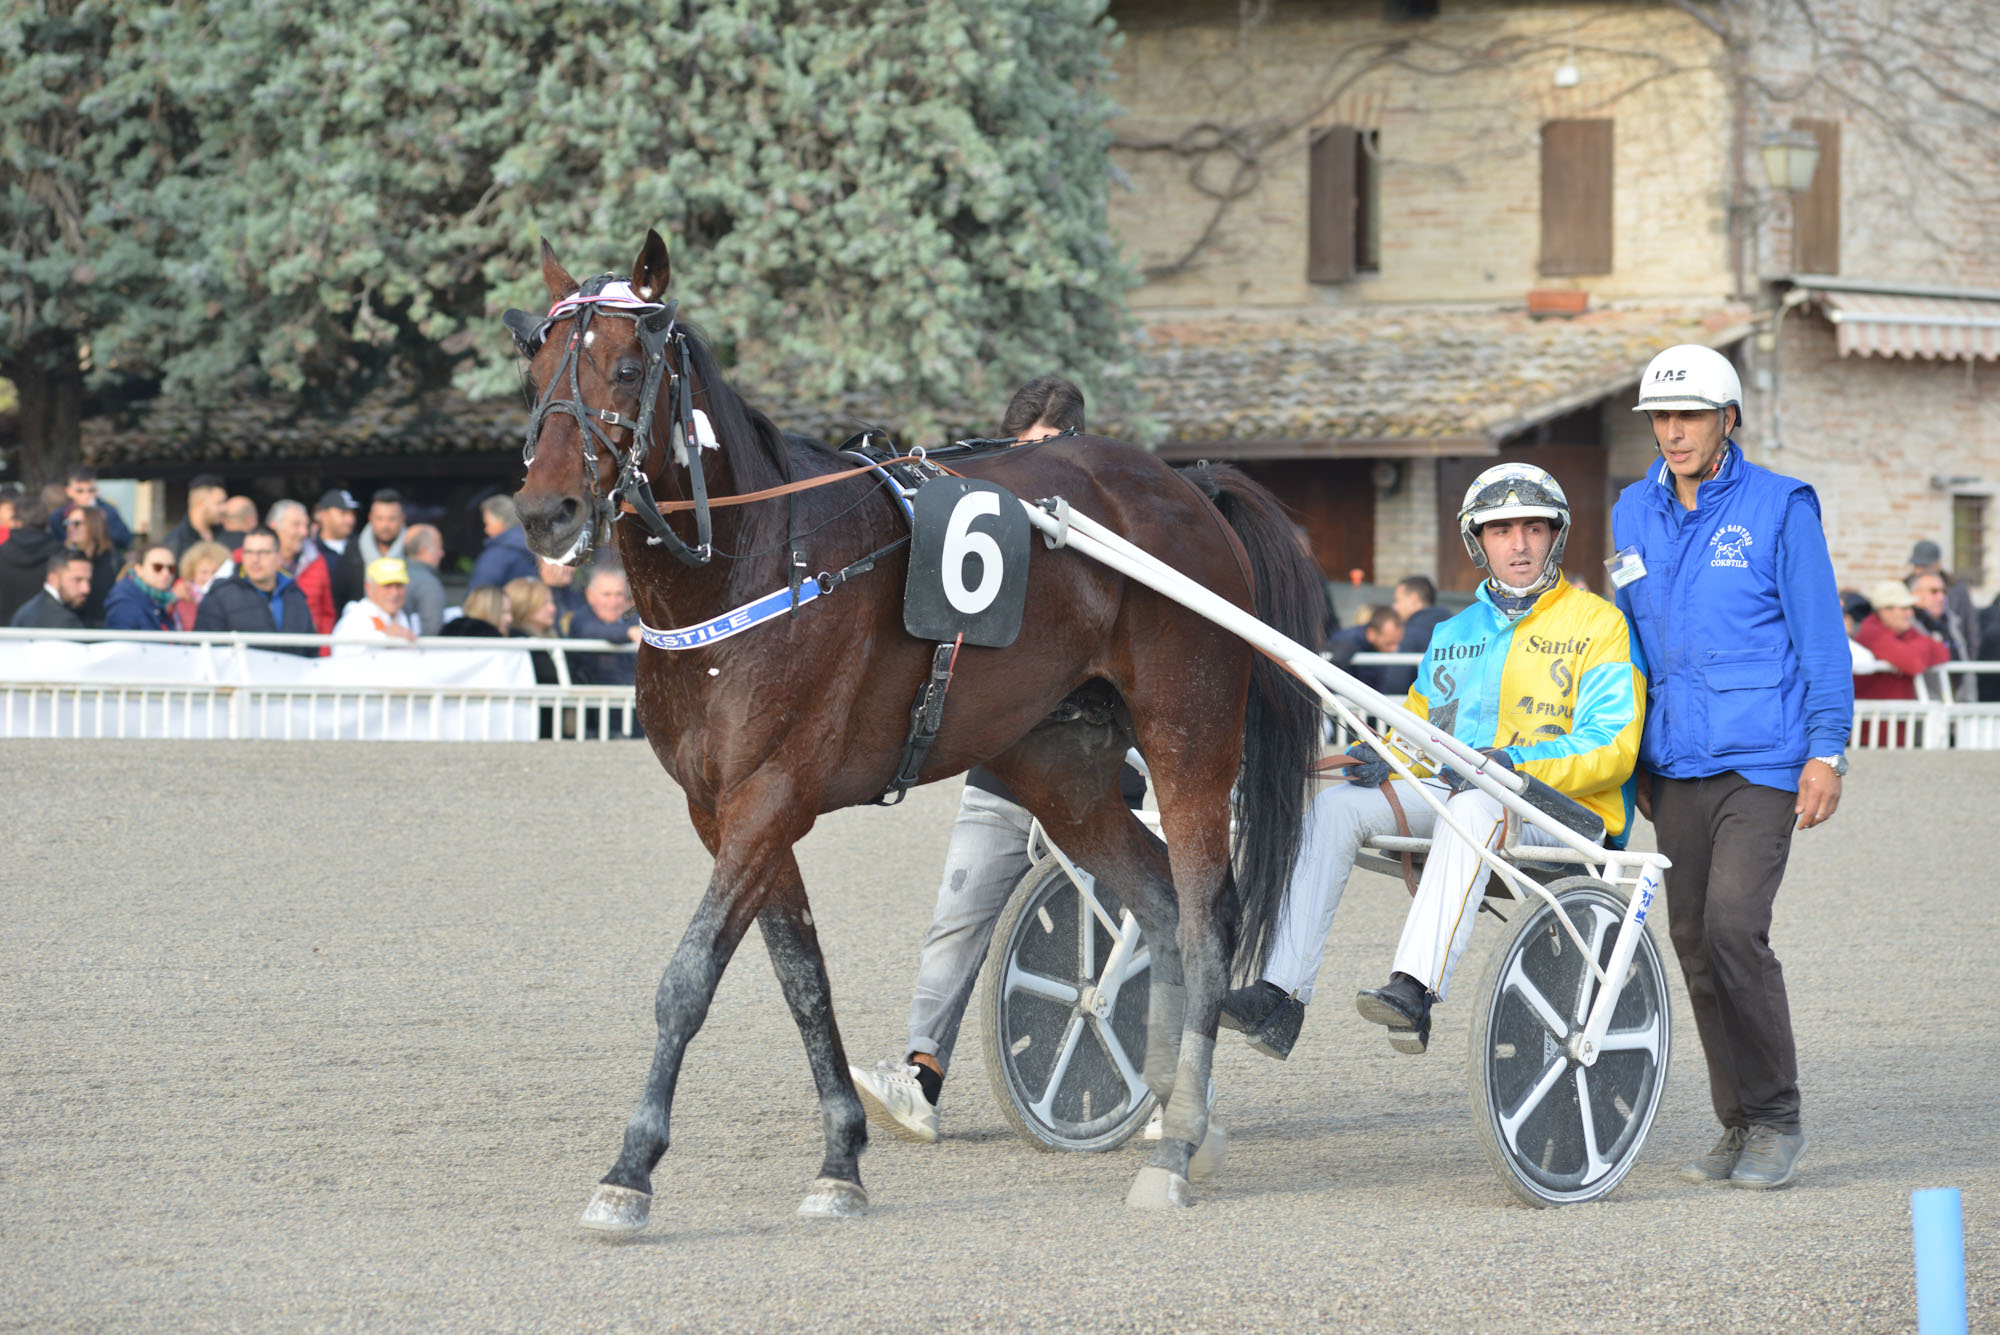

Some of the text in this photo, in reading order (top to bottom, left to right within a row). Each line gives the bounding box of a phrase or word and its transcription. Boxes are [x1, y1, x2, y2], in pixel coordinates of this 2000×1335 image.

[1709, 526, 1727, 547] TEAM
[941, 490, 1004, 615] 6
[1710, 559, 1748, 568] COKSTILE
